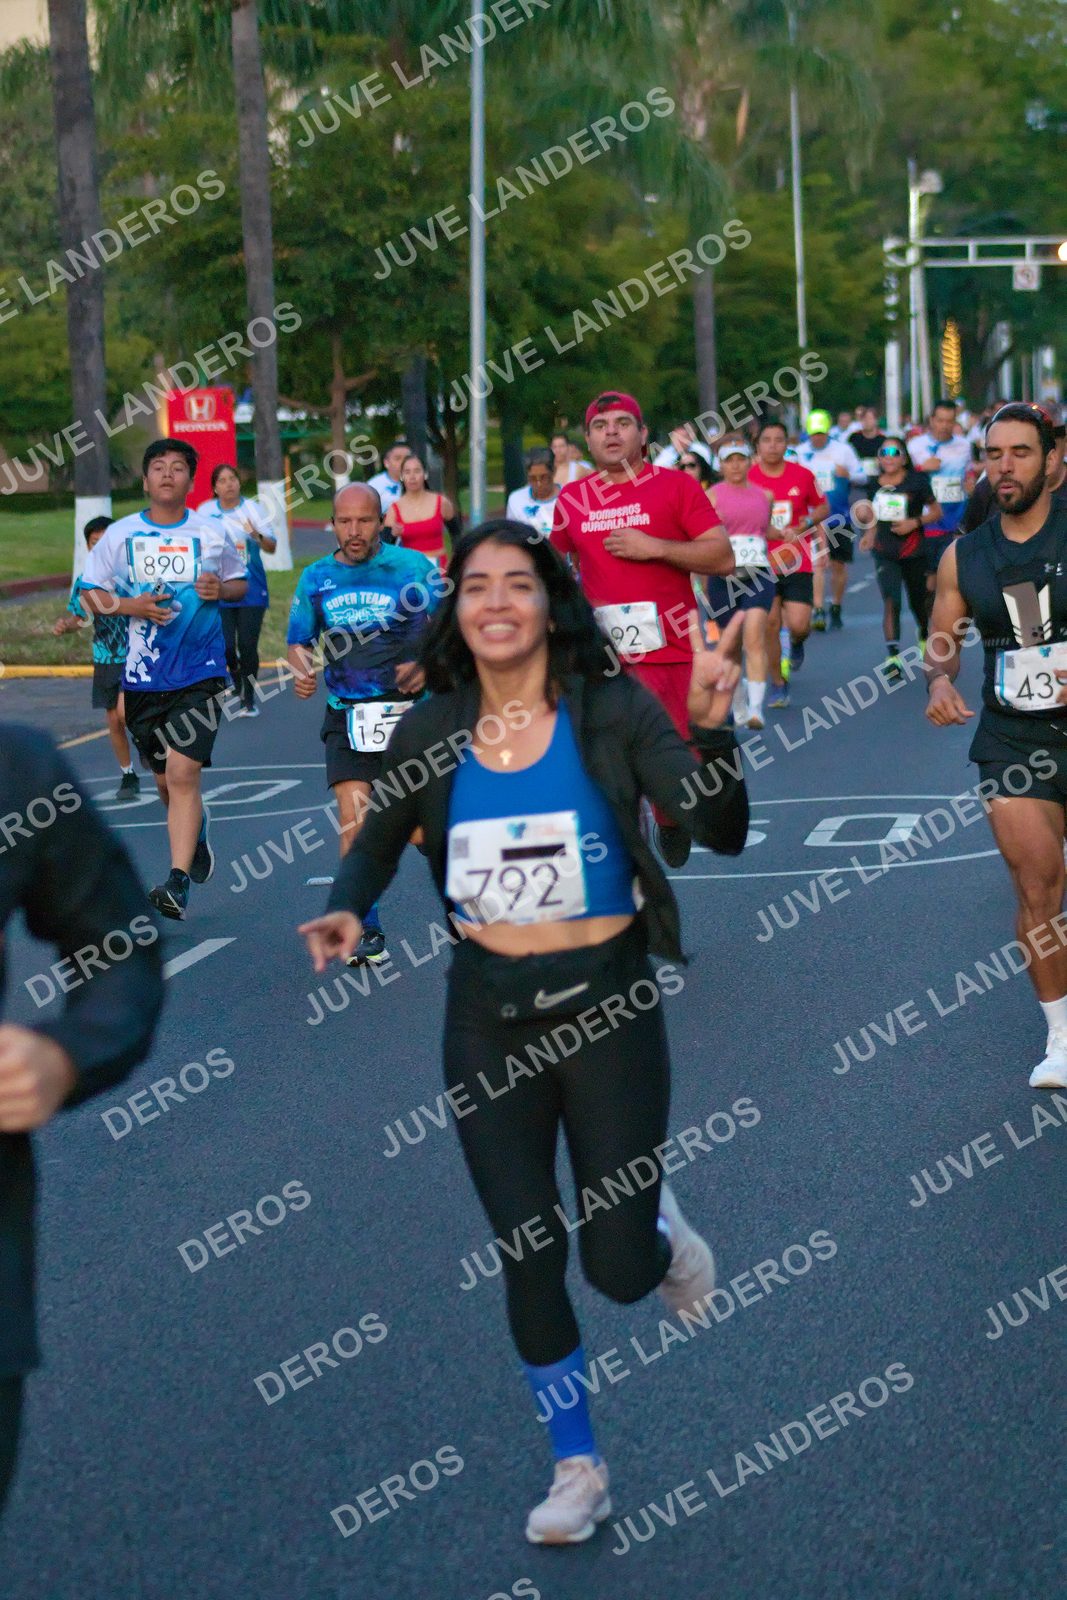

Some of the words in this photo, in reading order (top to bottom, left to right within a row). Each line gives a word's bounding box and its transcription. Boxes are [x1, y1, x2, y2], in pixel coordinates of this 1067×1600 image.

[588, 502, 642, 521] BOMBEROS
[581, 513, 650, 533] GUADALAJARA
[143, 555, 186, 576] 890
[325, 592, 358, 611] SUPER
[359, 590, 392, 606] TEAM
[1016, 671, 1067, 701] 43
[466, 862, 562, 911] 792
